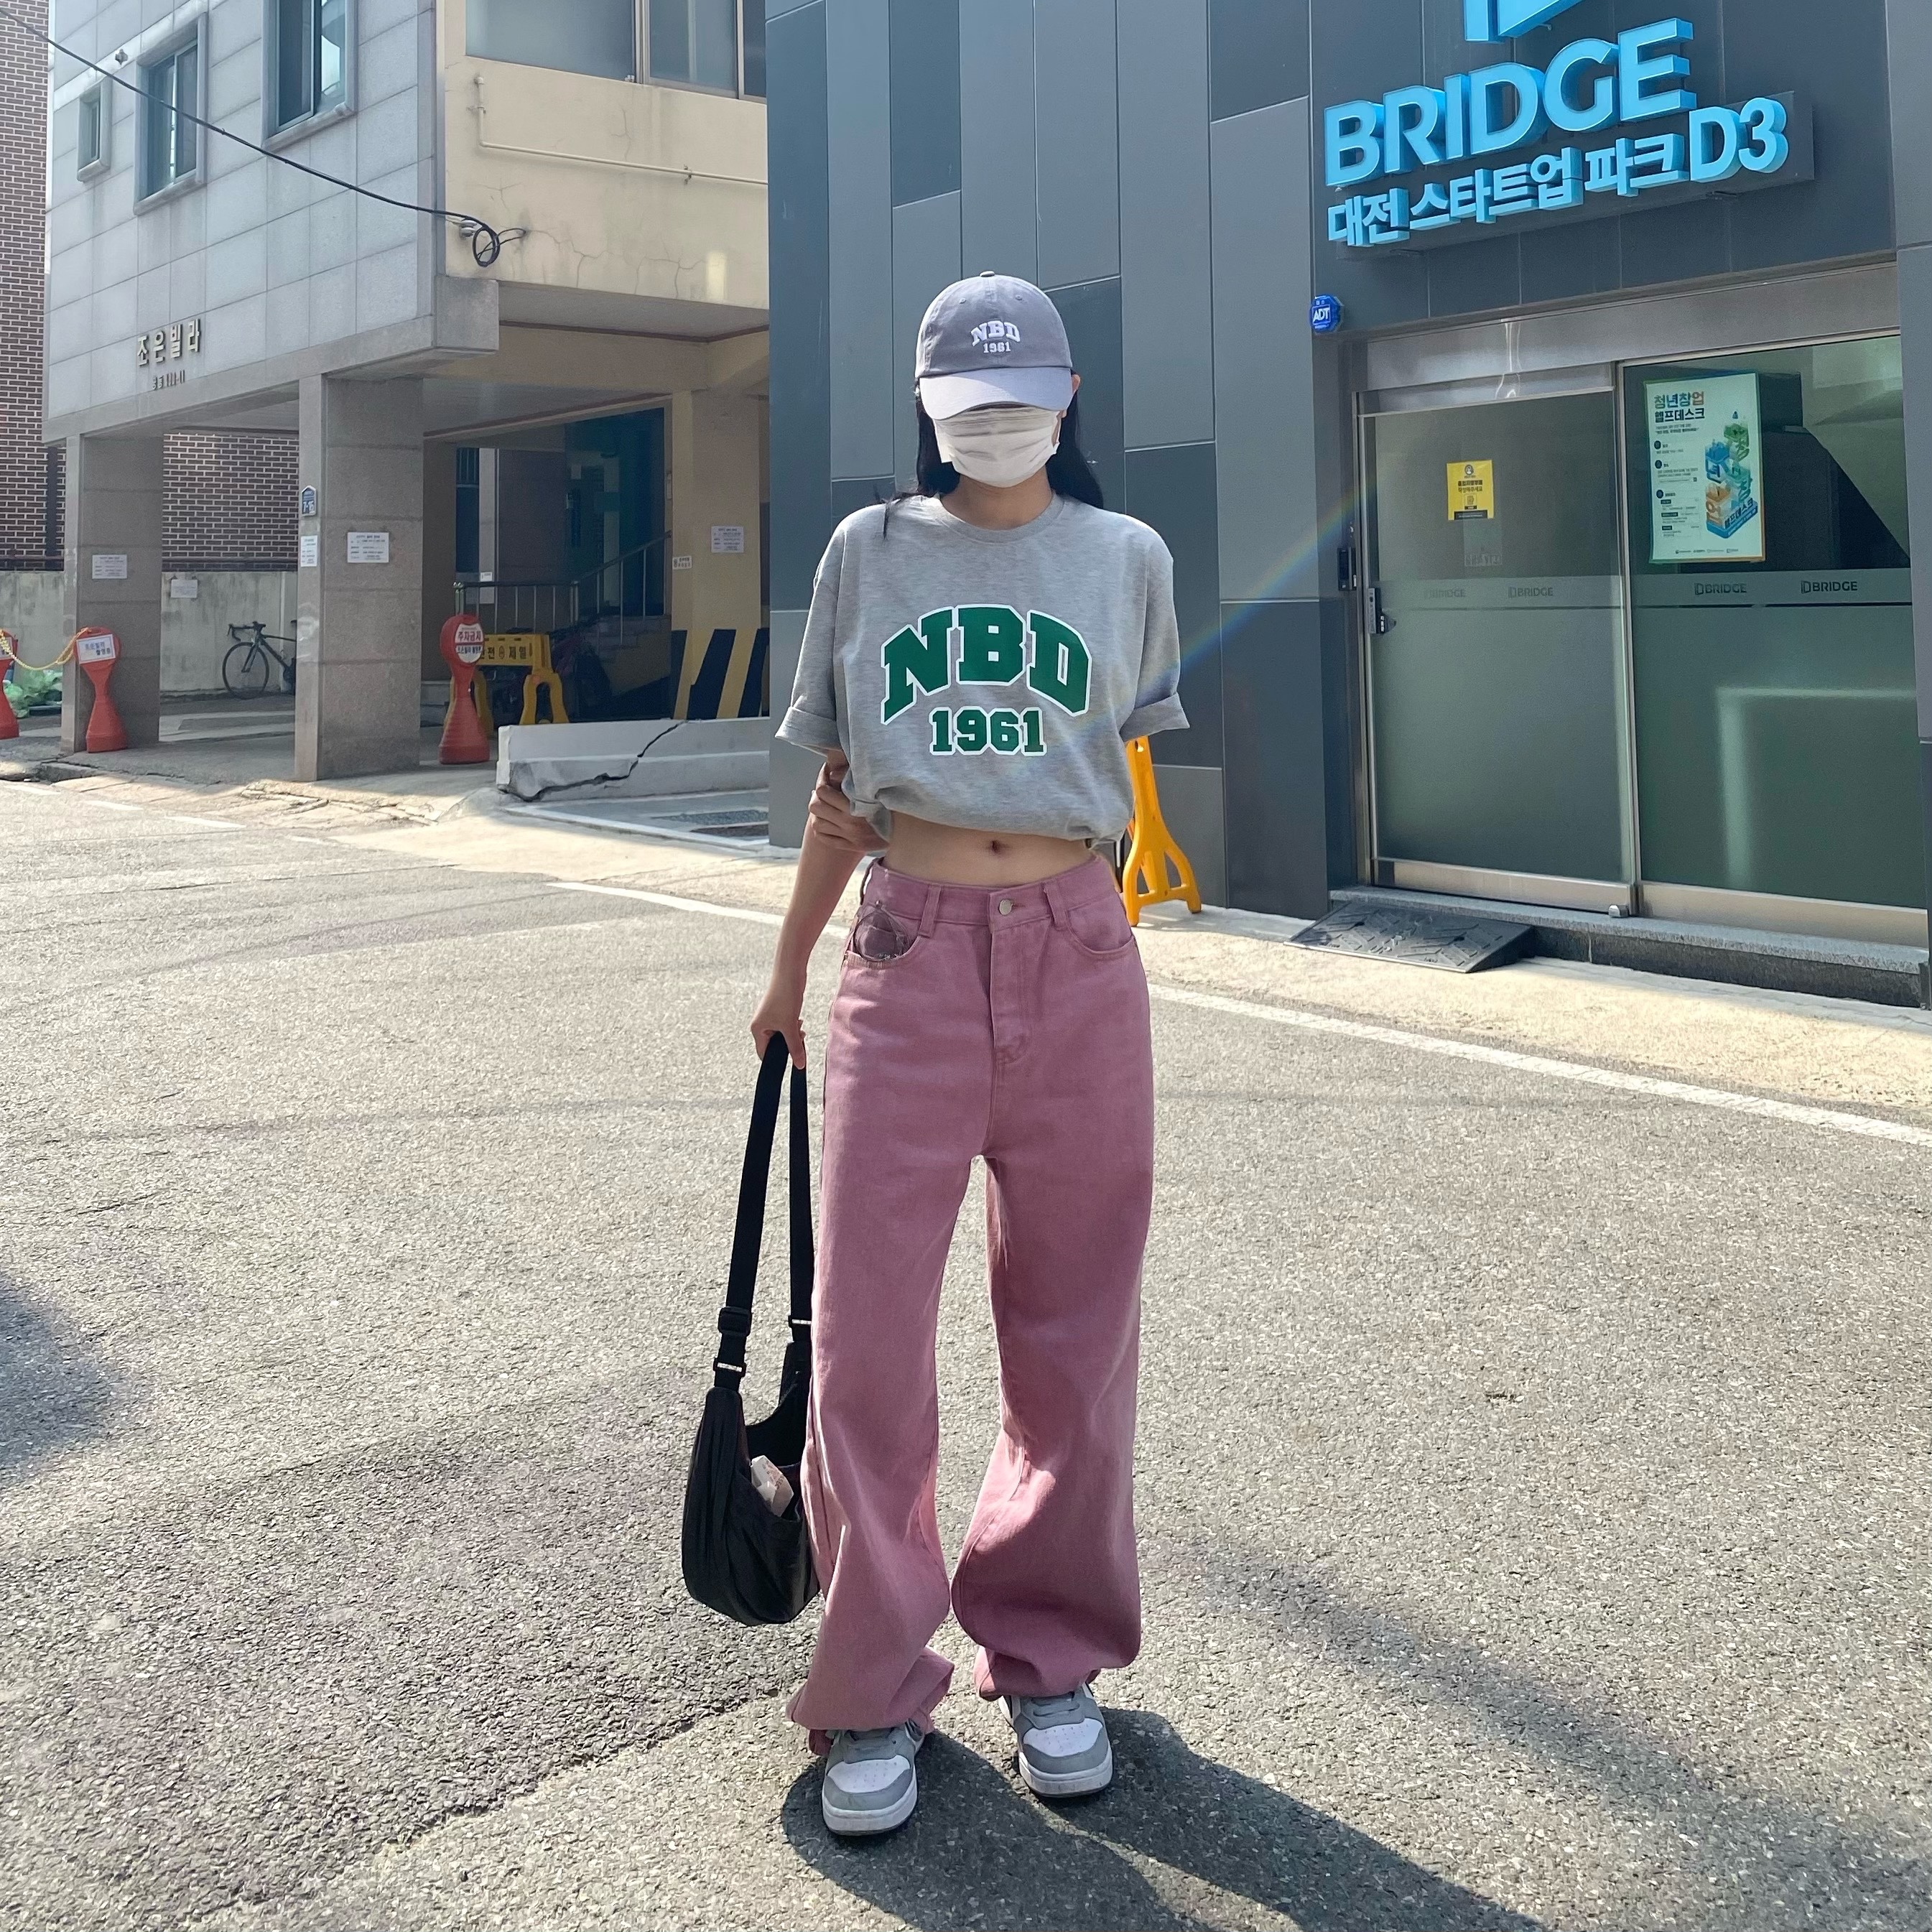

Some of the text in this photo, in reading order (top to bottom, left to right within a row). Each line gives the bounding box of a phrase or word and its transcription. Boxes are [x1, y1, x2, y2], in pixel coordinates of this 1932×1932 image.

[1324, 17, 1696, 187] BRIDGE
[1327, 97, 1788, 248] 대전 스타트업 파크 D3
[970, 320, 1021, 346] NBD
[1312, 307, 1330, 323] ADT
[137, 319, 201, 368] 조은빌라
[983, 342, 1011, 353] 1961
[1654, 391, 1705, 409] 청년창업
[881, 603, 1092, 726] NBD
[928, 706, 1047, 756] 1961
